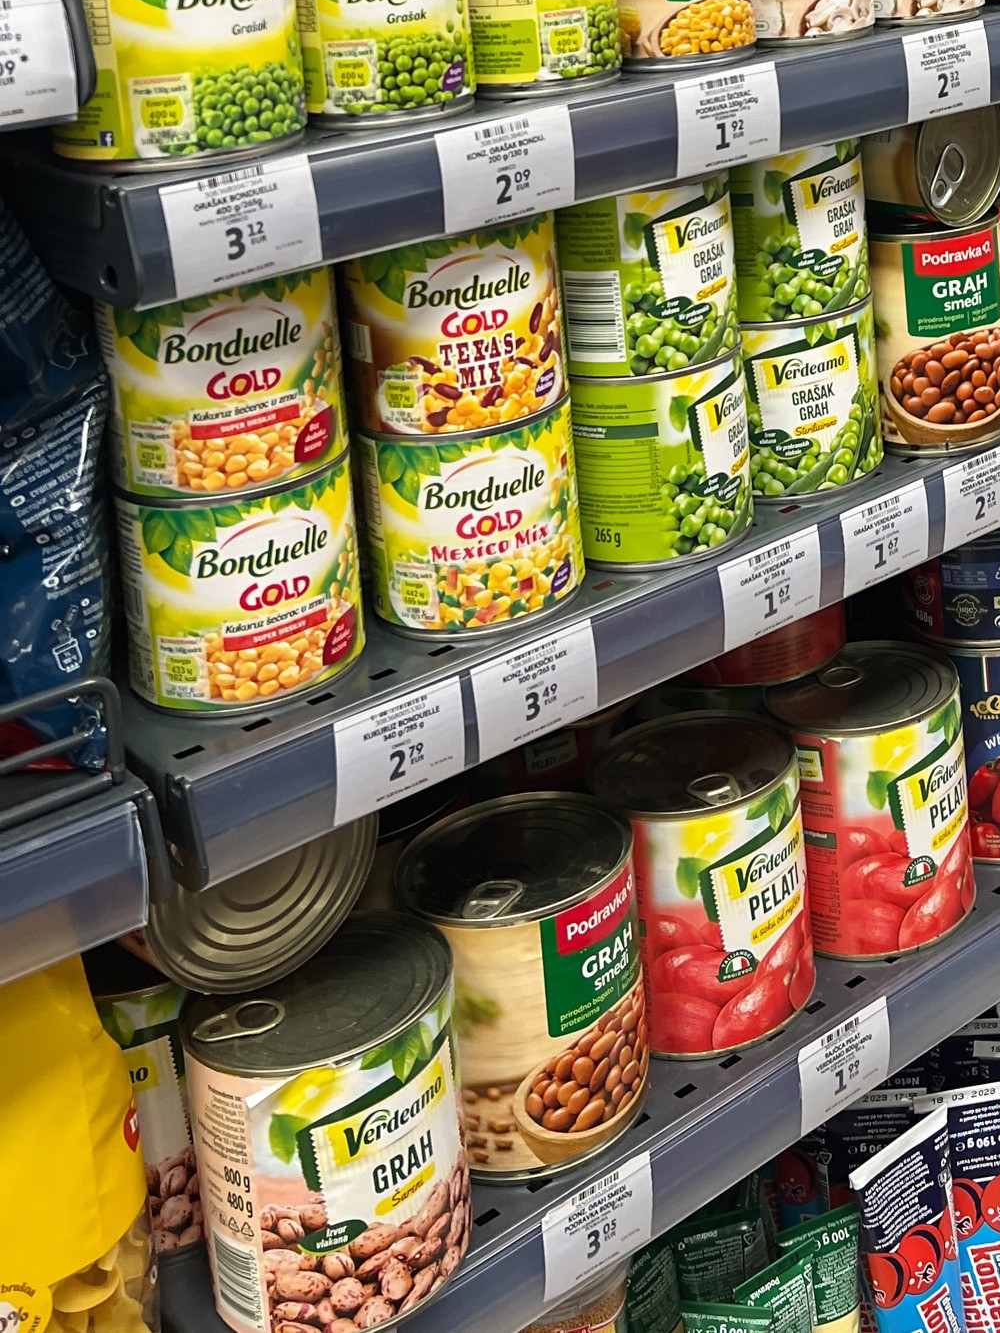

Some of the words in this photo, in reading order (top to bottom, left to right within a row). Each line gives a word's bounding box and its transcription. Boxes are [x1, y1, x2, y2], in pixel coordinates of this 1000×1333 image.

[938, 73, 948, 97] 2
[496, 177, 512, 204] 2
[514, 169, 530, 183] 09
[248, 222, 264, 235] 12
[250, 235, 266, 244] EUR
[225, 228, 245, 260] 3
[922, 250, 983, 266] Podravka
[407, 266, 529, 311] Bonduelle
[933, 275, 988, 298] GRAH
[944, 293, 982, 311] smeđi
[918, 316, 943, 327] prirodno
[944, 313, 964, 325] bogato
[164, 321, 301, 366] Bonduelle
[440, 330, 516, 366] TEXAS
[460, 363, 501, 392] MIX
[773, 353, 846, 386] Verdeamo
[207, 368, 281, 399] GOLD
[792, 385, 835, 407] GRAŠAK
[192, 410, 232, 422] Kukuruz
[221, 421, 248, 433] SUPER
[249, 414, 277, 427] HRSKAV
[799, 401, 830, 420] GRAH
[431, 539, 509, 563] Mexico
[515, 523, 549, 546] Mix
[594, 527, 613, 547] 265
[389, 749, 406, 782] 2
[407, 742, 424, 757] 79
[736, 827, 800, 894] Verdeamo
[748, 865, 800, 922] PELATI
[344, 1076, 442, 1157] Verdeamo
[373, 1129, 434, 1195] GRAH
[224, 1166, 240, 1187] 800
[316, 1233, 348, 1249] vlakana
[326, 1225, 348, 1239] Izvor
[586, 1229, 601, 1259] 3
[602, 1218, 617, 1235] 05
